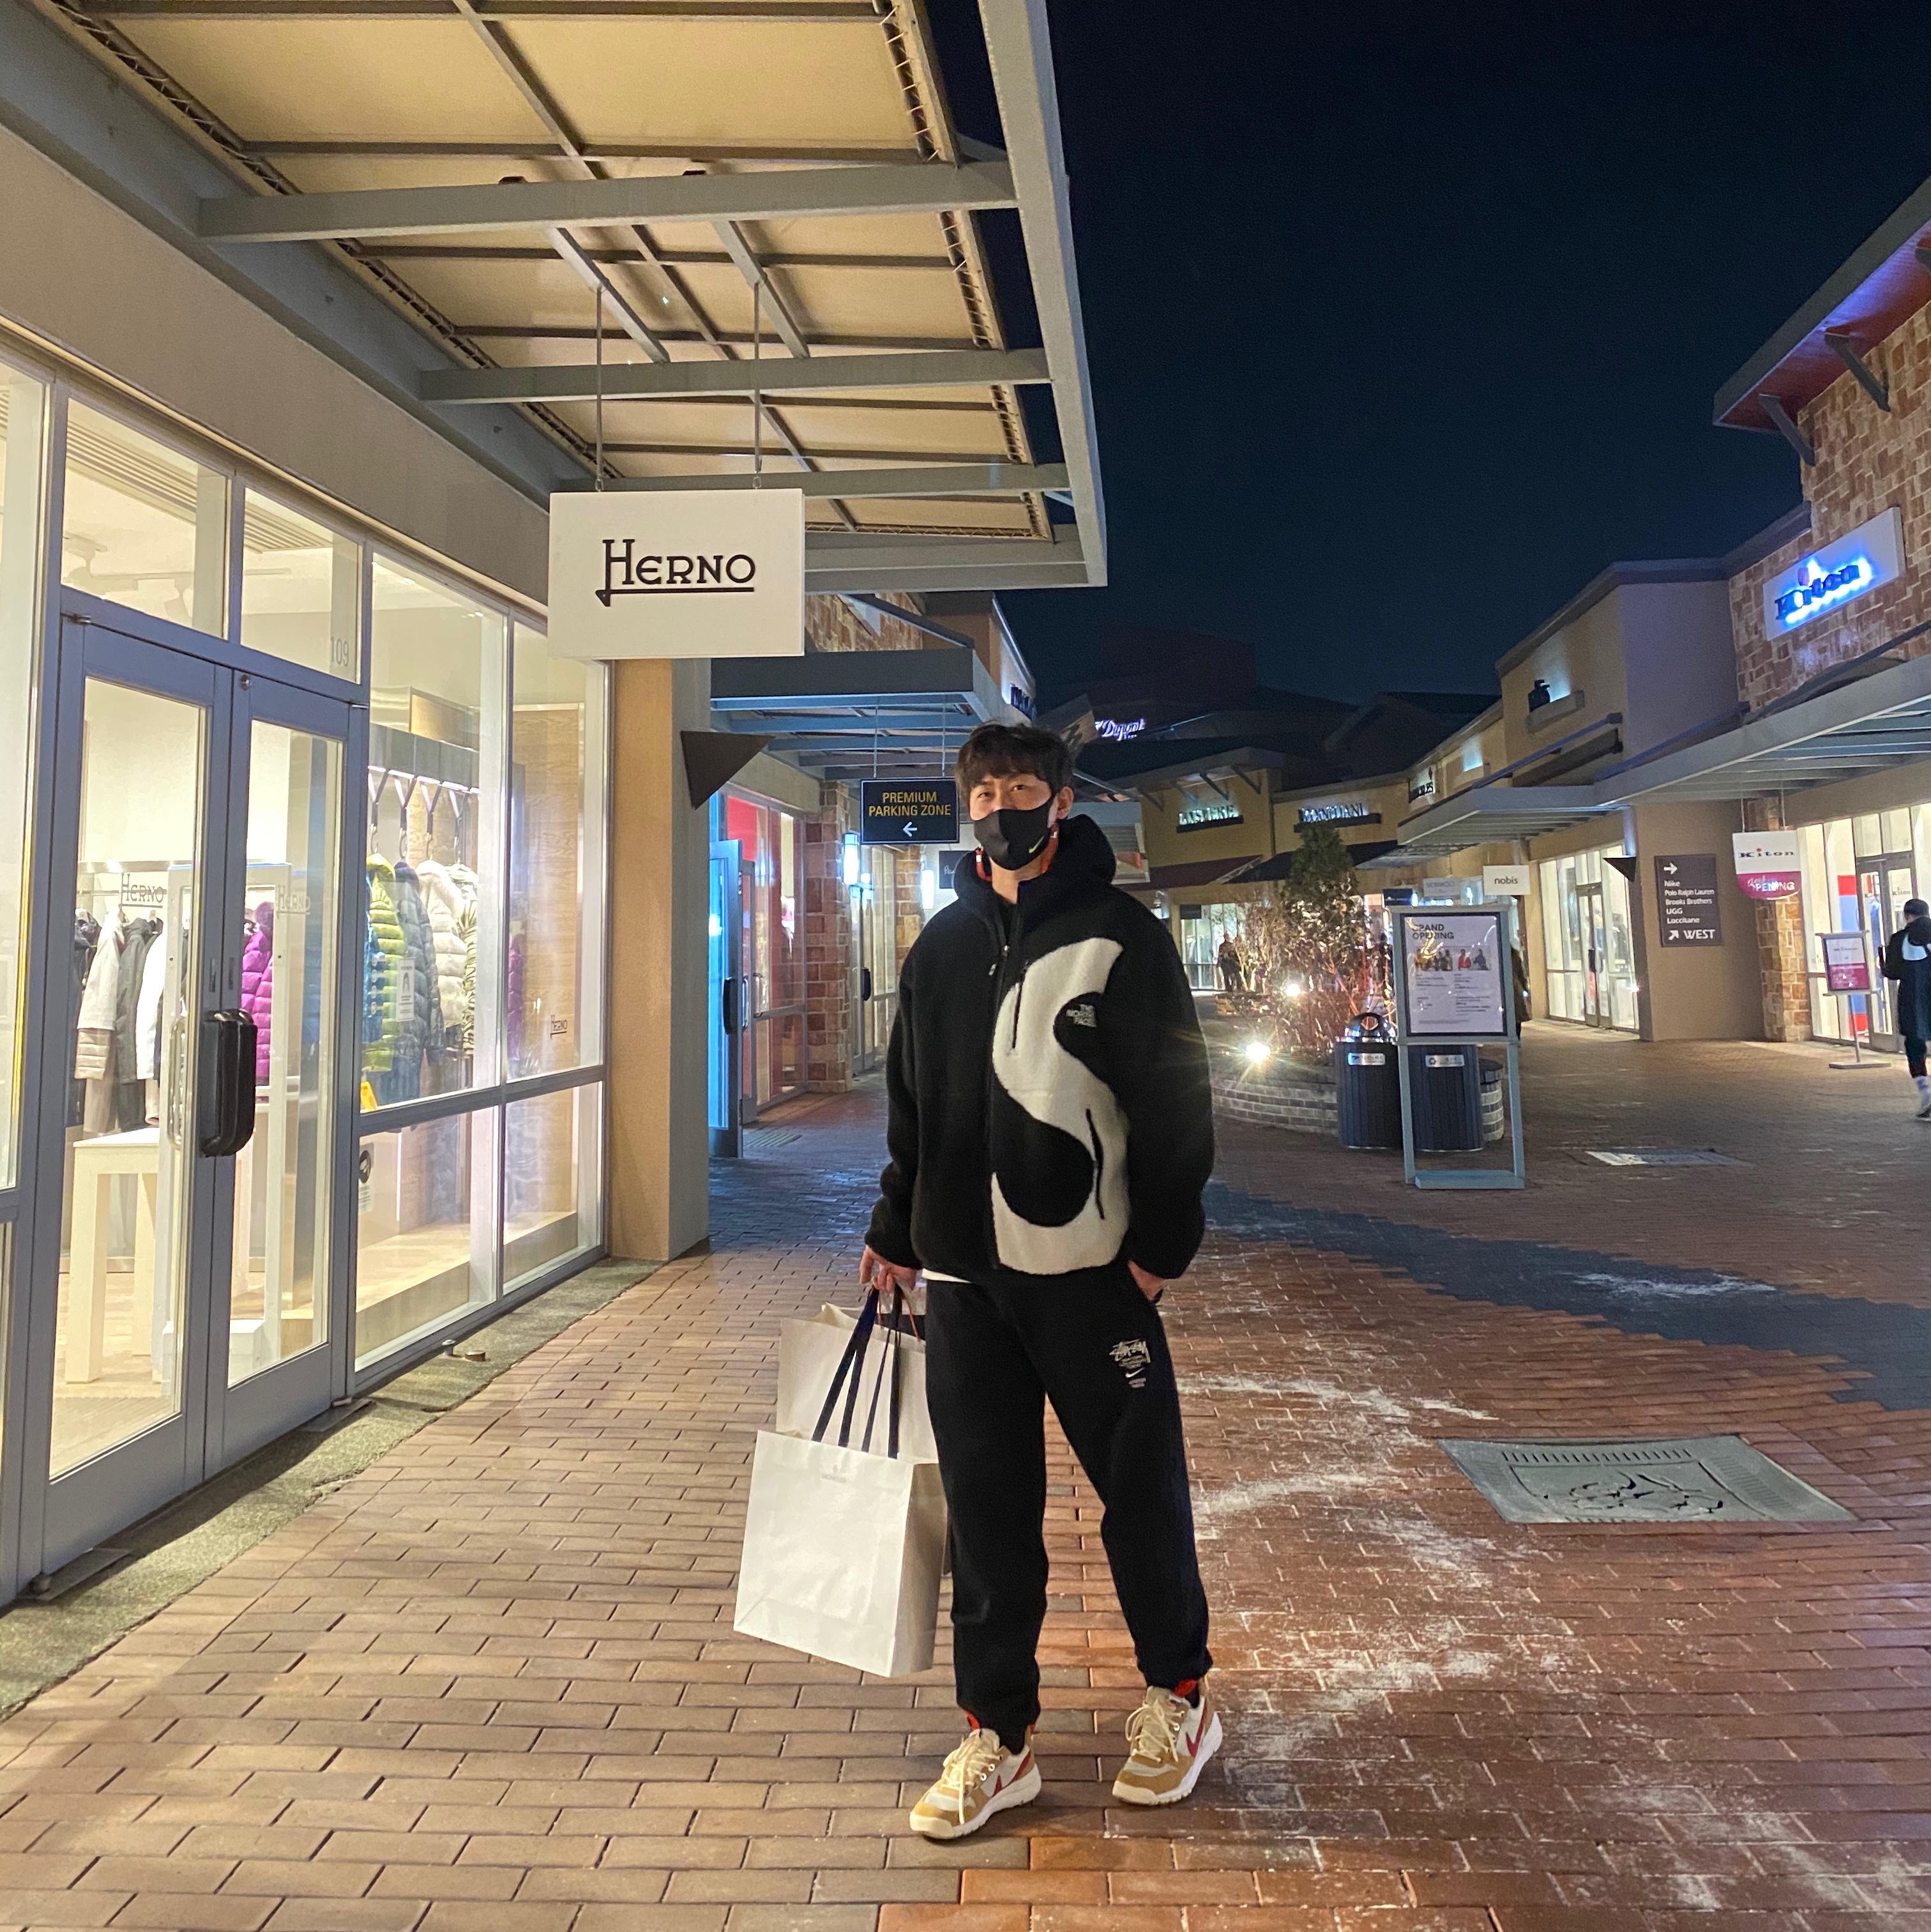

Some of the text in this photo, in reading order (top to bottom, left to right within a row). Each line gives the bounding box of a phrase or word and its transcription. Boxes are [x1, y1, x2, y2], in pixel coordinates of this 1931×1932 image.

[599, 538, 755, 595] HERNO
[331, 636, 349, 666] 109
[882, 791, 937, 803] PREMIUM
[868, 804, 951, 816] PARKING ZONE
[1738, 848, 1794, 858] Kiton
[1494, 876, 1518, 885] nobis
[120, 873, 164, 906] HERNO
[1677, 889, 1694, 897] Ralph
[1683, 929, 1715, 939] WEST
